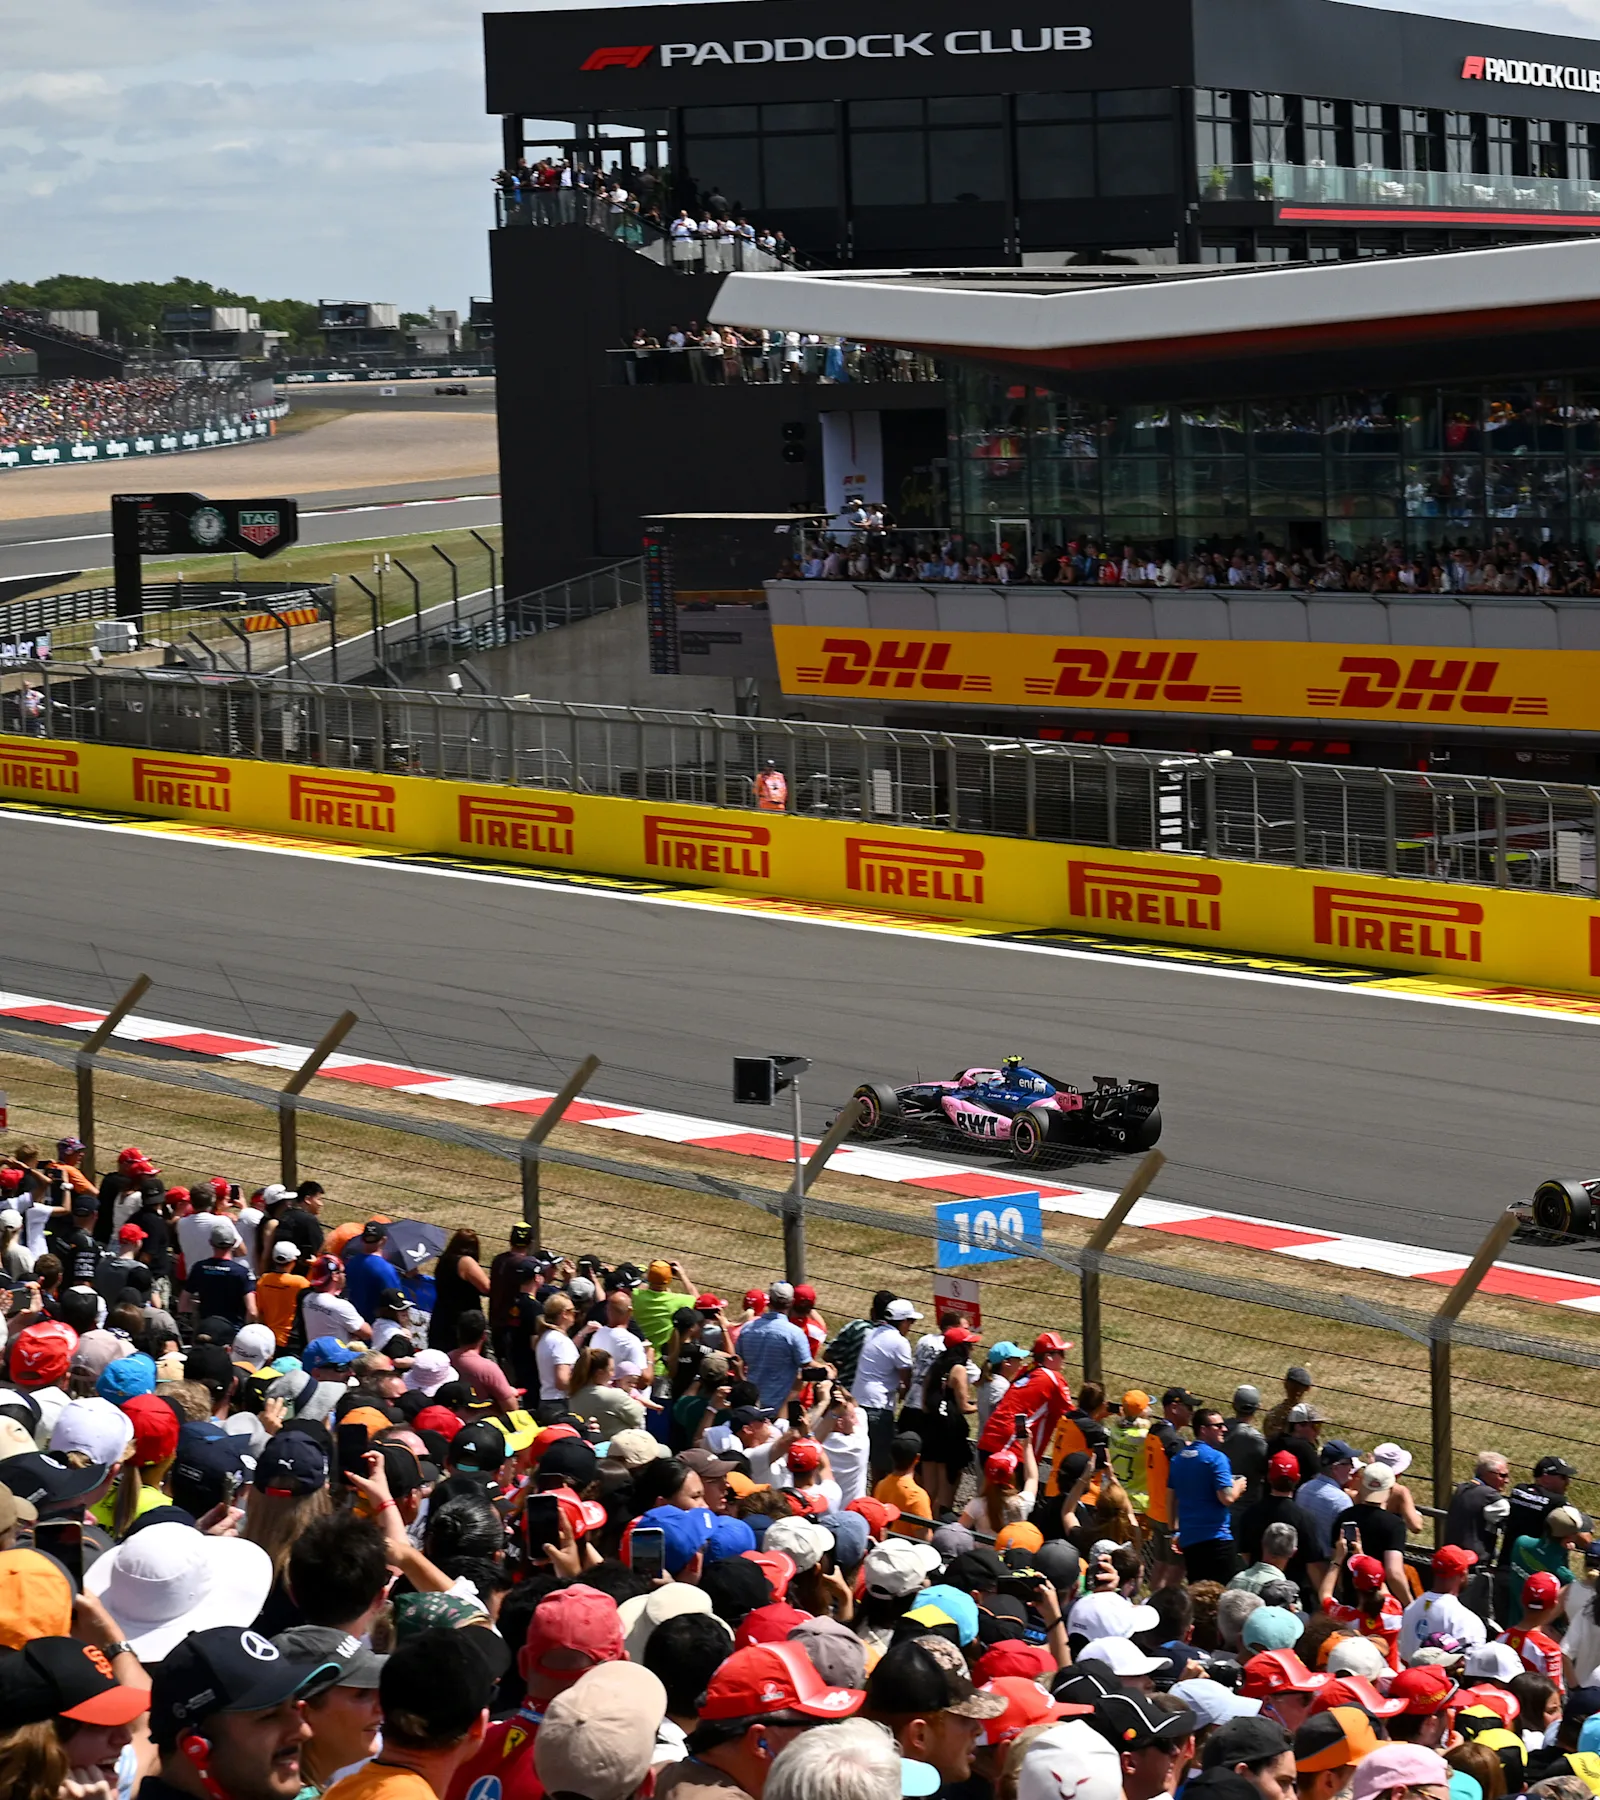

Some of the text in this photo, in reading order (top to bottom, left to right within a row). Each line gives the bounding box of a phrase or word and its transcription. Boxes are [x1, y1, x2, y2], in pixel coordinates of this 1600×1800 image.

[660, 33, 936, 66] PADDOCK
[944, 25, 1094, 54] CLUB
[1486, 57, 1564, 88] PADDOCK
[242, 513, 276, 525] TAG
[819, 639, 964, 691] DHL
[1053, 648, 1211, 703] DHL
[1338, 656, 1513, 714] DHL
[134, 758, 230, 812] PIRELLI
[291, 775, 395, 833] PIRELLI
[460, 796, 574, 855] PIRELLI
[645, 816, 770, 878] PIRELLI
[847, 838, 984, 904] PIRELLI
[1069, 861, 1221, 931] PIRELLI
[1315, 887, 1483, 962] PIRELLI
[1018, 1077, 1034, 1089] eni
[1093, 1085, 1139, 1098] ALPINE
[956, 1111, 998, 1137] BWT
[954, 1207, 1024, 1254] 100
